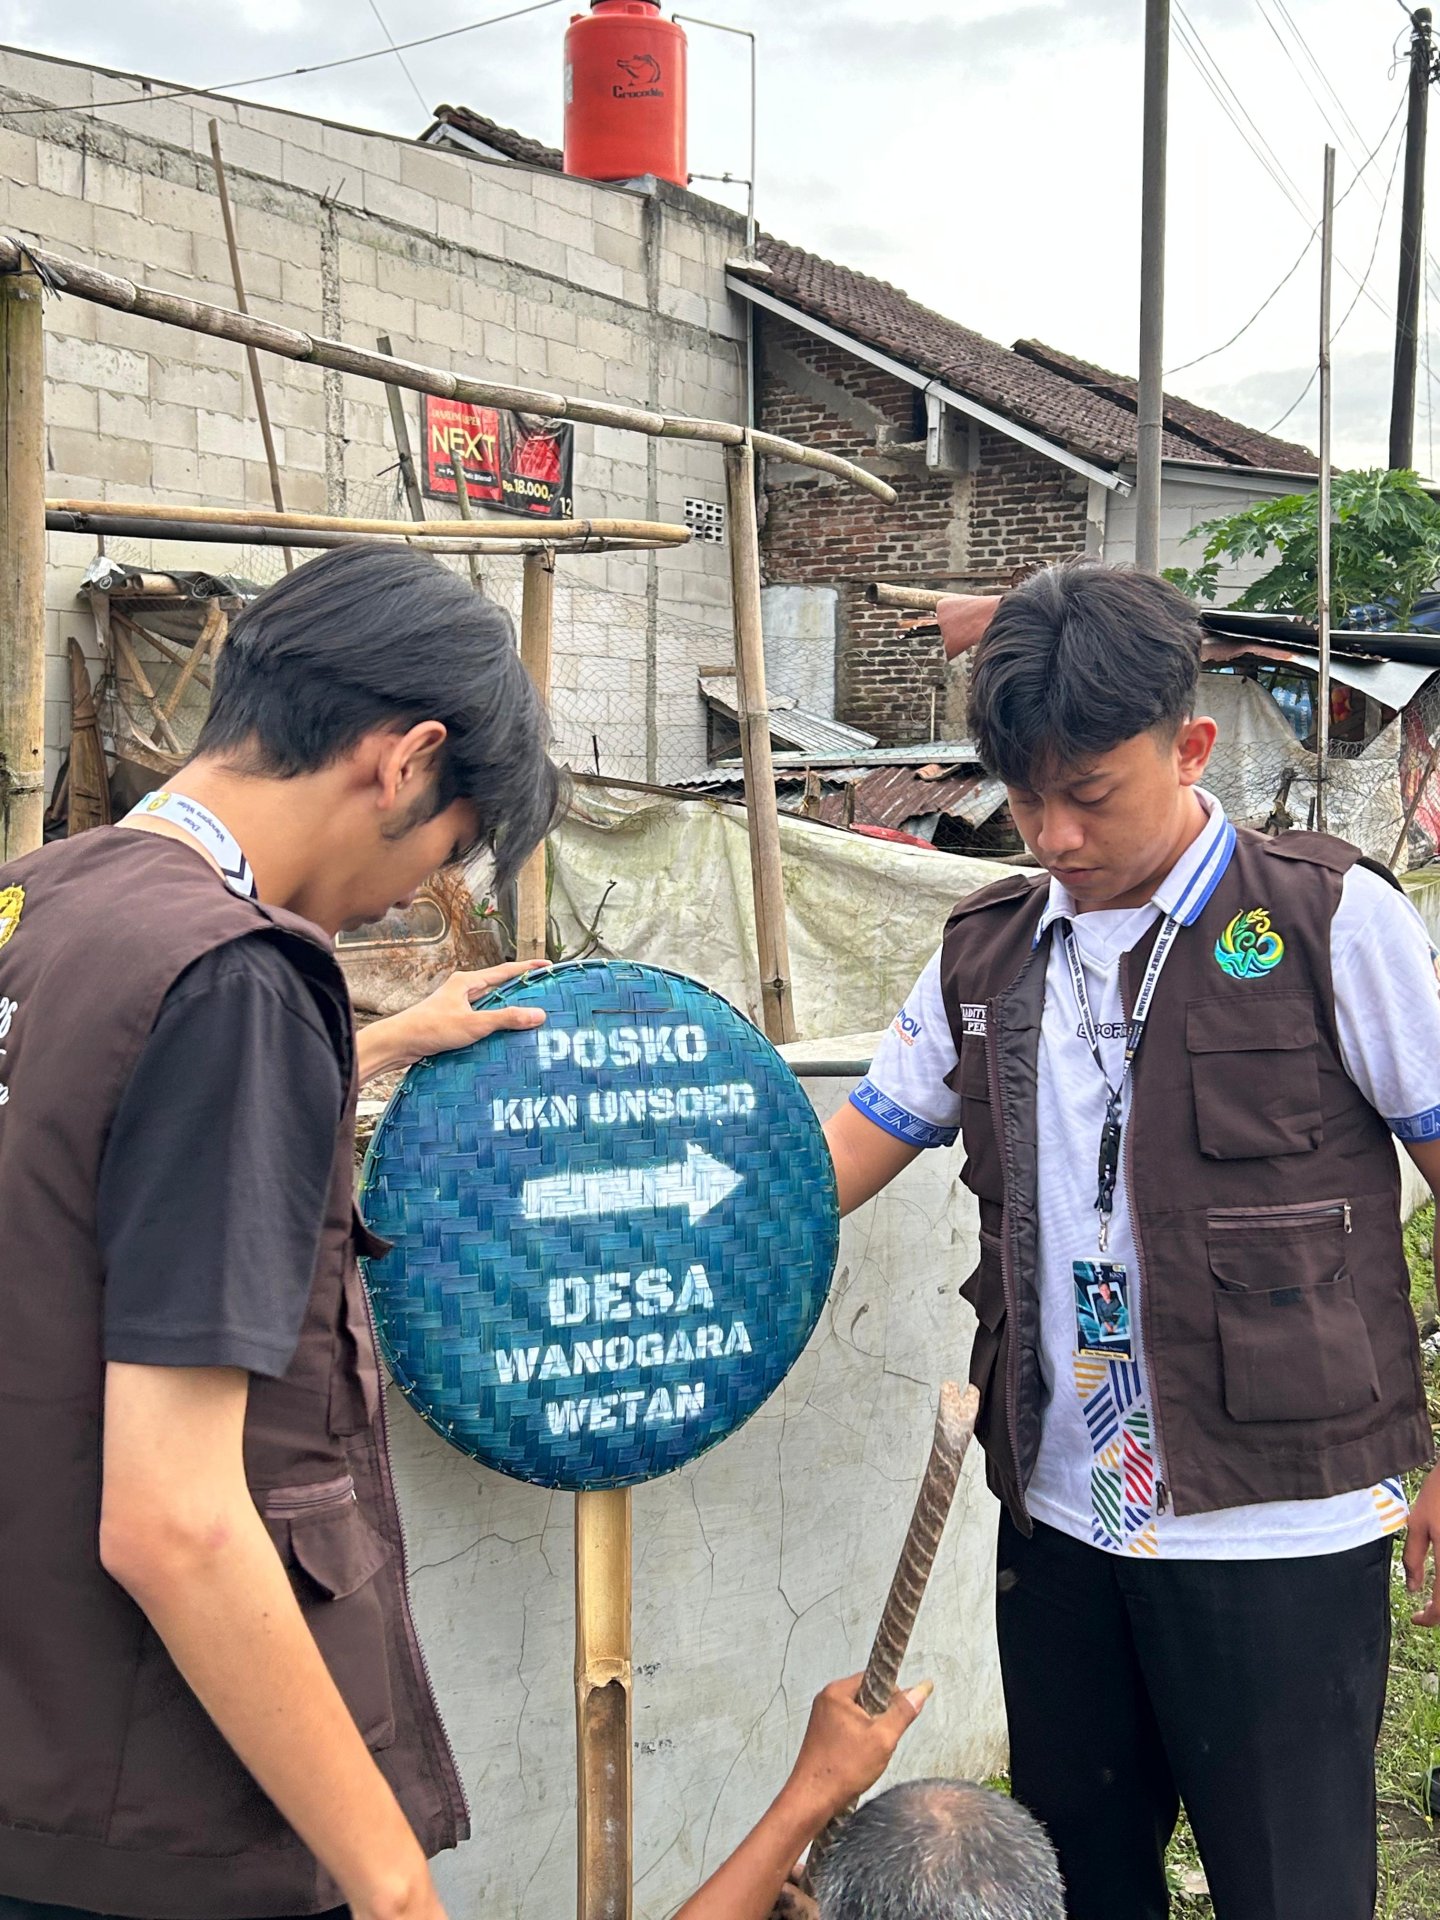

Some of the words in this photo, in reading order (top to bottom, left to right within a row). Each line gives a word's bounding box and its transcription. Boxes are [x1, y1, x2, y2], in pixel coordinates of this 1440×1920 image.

[431, 423, 497, 464] NEXT
[1136, 972, 1156, 1017] UNIVERSITAS
[1151, 938, 1170, 971] JENDERAL
[537, 1024, 708, 1070] POSKO
[492, 1092, 578, 1131] KKN
[588, 1083, 757, 1124] UNSOED
[549, 1264, 715, 1327] DESA
[495, 1321, 753, 1383] WANOGARA
[545, 1382, 706, 1435] WETAN
